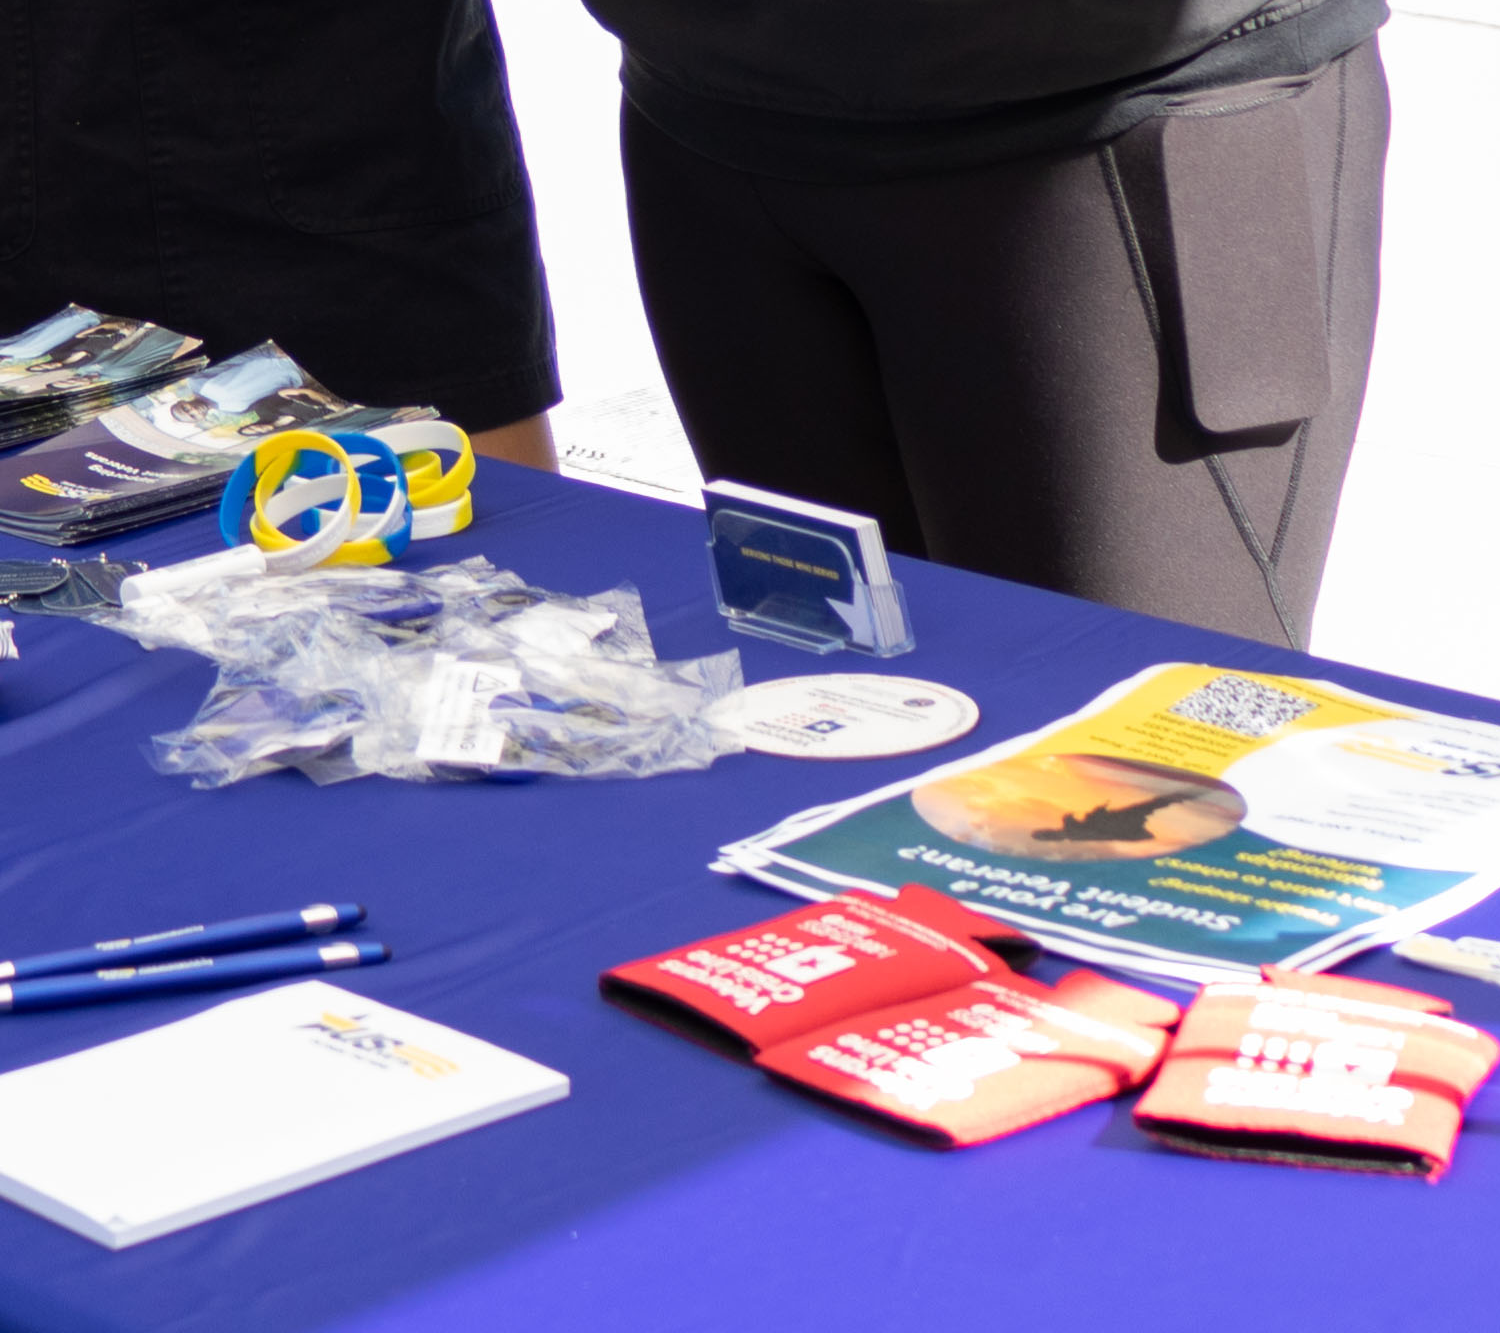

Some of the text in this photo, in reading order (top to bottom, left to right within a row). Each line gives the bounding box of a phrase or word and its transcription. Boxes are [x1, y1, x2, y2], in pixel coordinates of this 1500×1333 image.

[897, 844, 1242, 931] Student Veteran?
[950, 880, 1138, 929] Are you a
